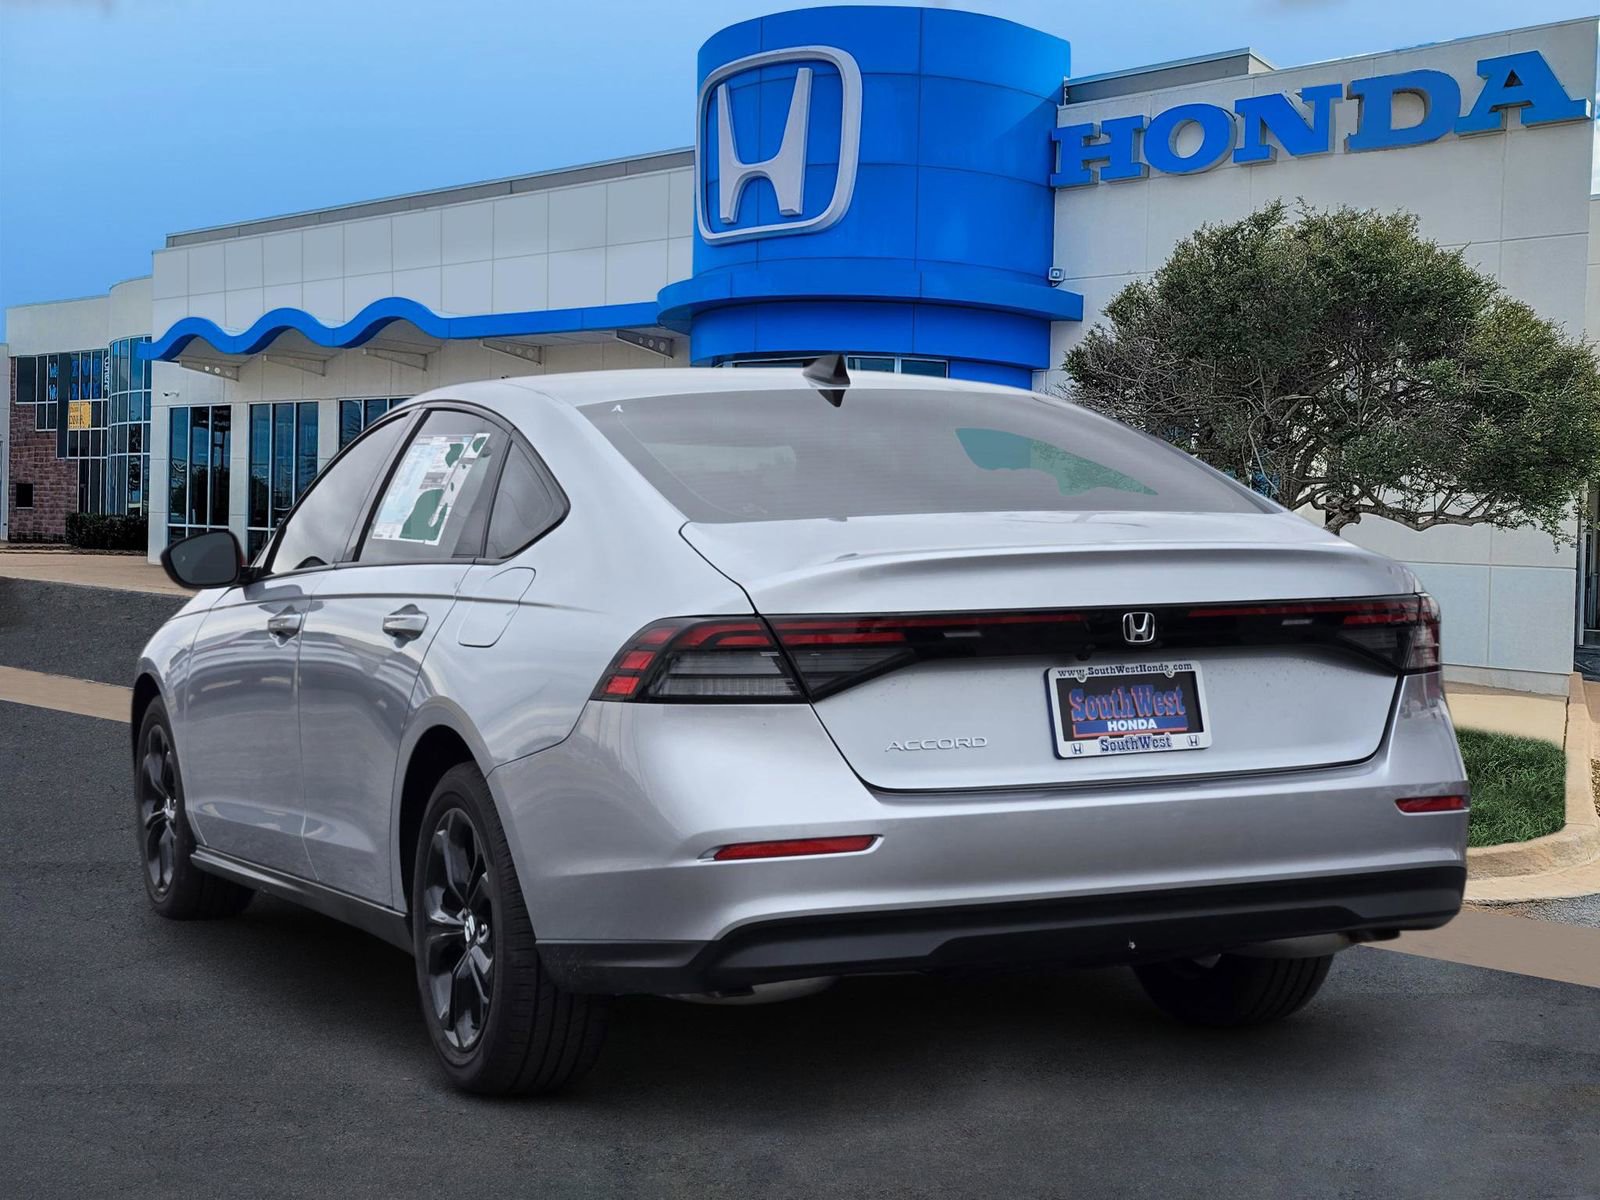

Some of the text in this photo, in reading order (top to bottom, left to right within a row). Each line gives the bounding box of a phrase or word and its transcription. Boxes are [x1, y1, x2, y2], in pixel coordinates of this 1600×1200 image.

[1051, 50, 1591, 188] HONDA
[1057, 663, 1192, 678] www.SouthWestHondacom
[1069, 685, 1186, 721] SouthWest
[1107, 719, 1158, 732] HONDA
[884, 736, 988, 752] ACCORD
[1101, 735, 1172, 752] SouthWest
